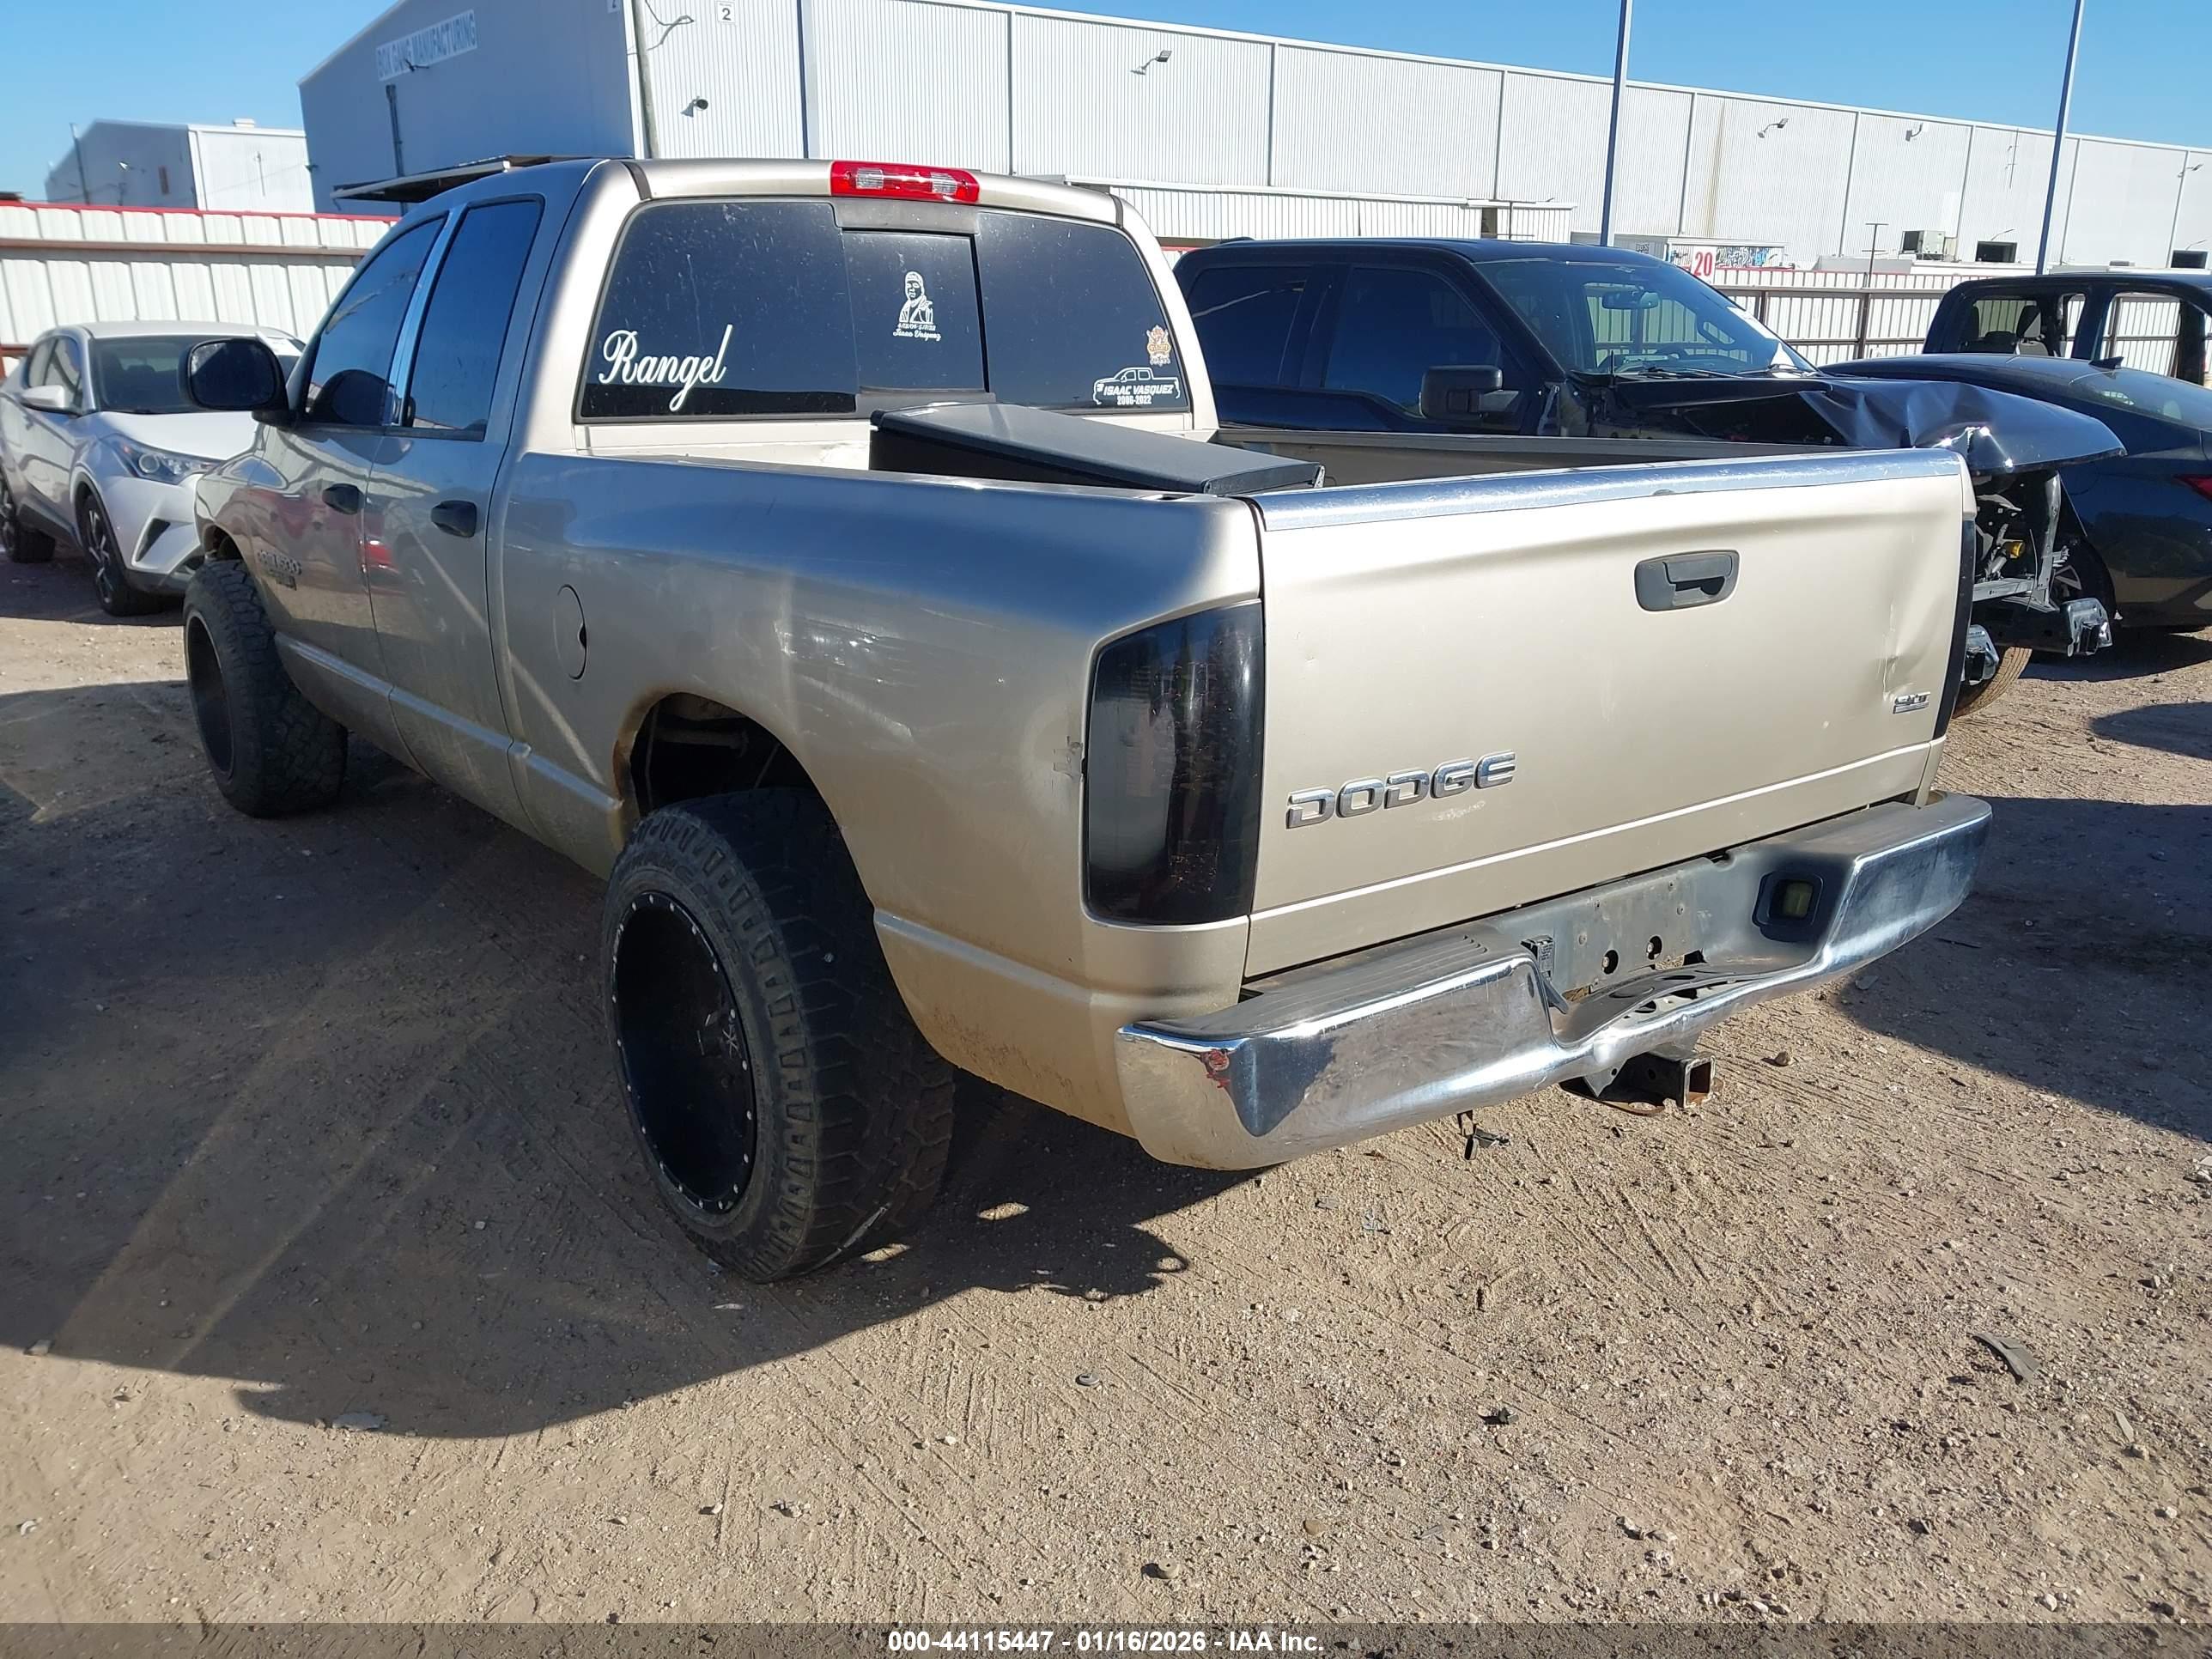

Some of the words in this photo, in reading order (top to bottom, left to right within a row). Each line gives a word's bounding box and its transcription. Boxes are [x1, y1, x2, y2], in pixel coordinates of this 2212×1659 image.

[722, 8, 731, 21] 2
[1694, 252, 1713, 276] 20
[599, 324, 732, 412] Rangel
[1103, 385, 1131, 395] ISAAC
[1133, 384, 1174, 395] VASQUEZ
[1285, 750, 1516, 829] DODGE
